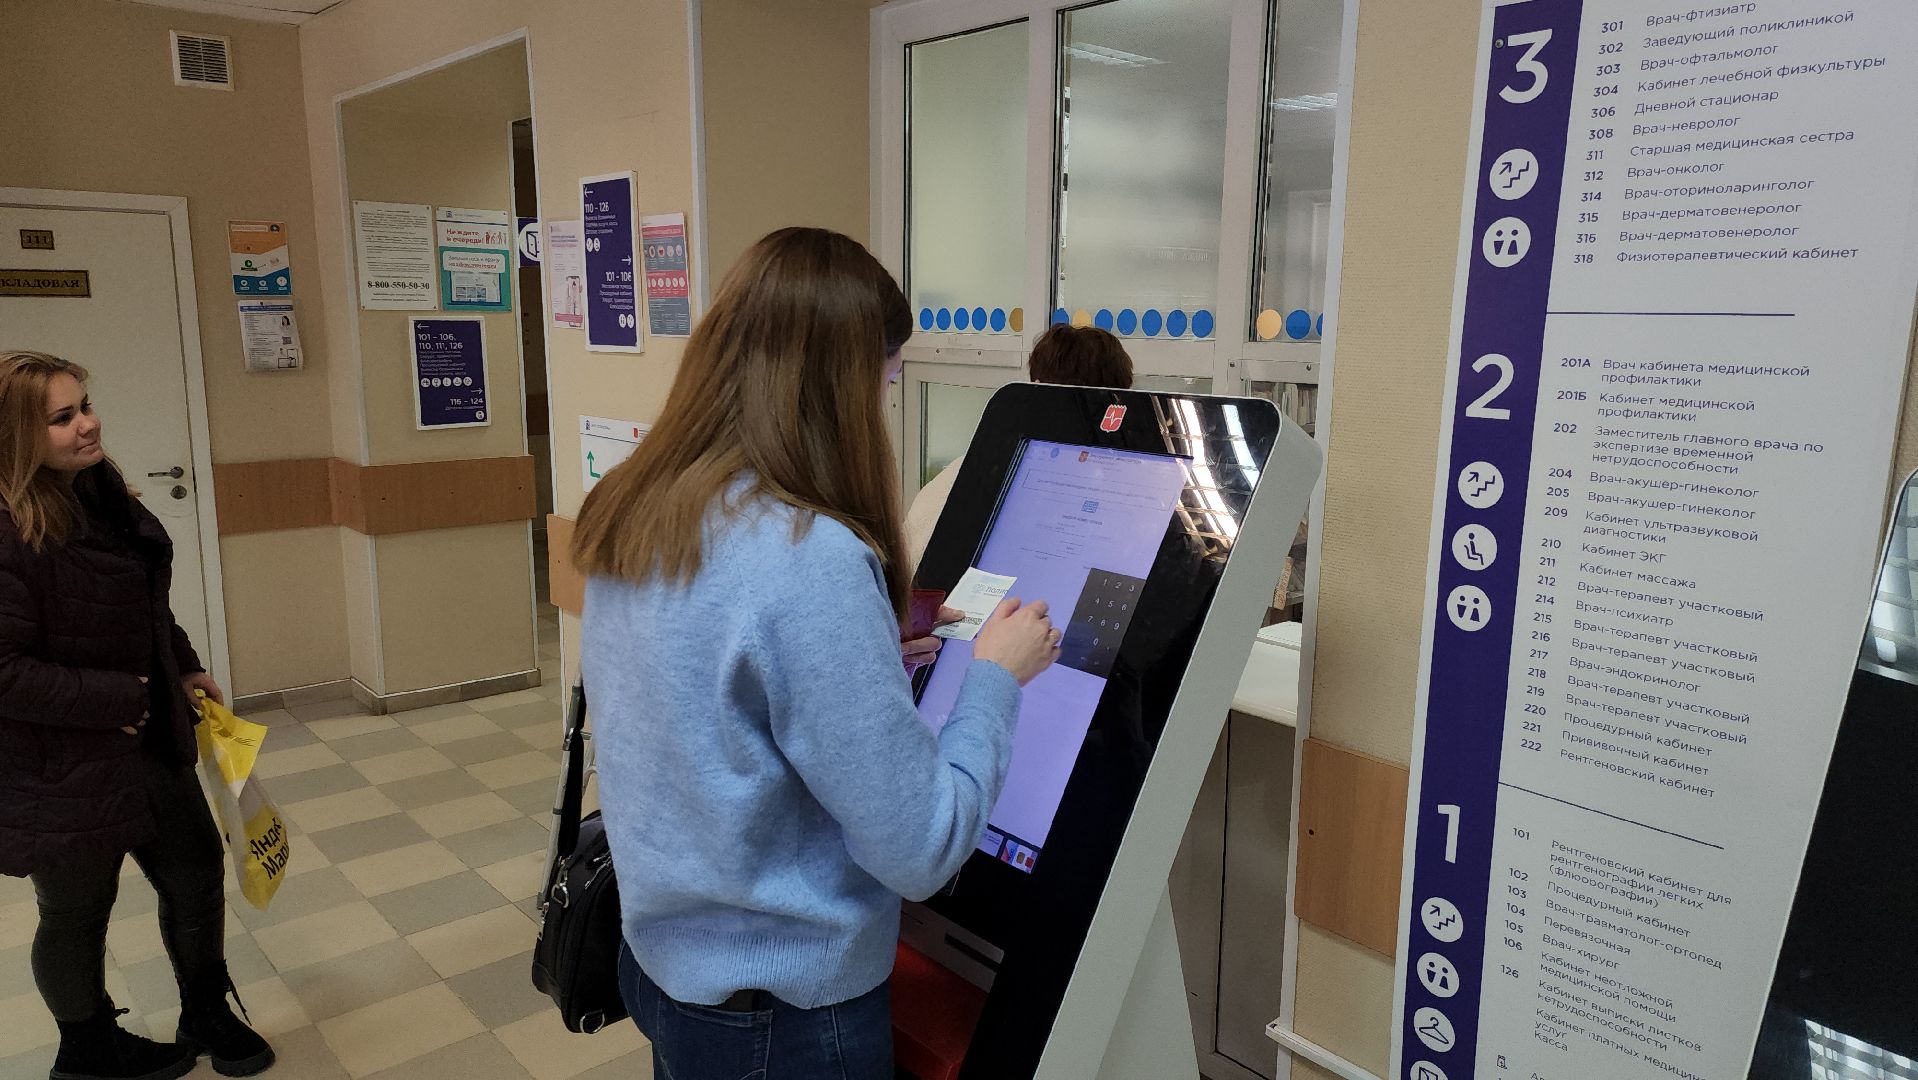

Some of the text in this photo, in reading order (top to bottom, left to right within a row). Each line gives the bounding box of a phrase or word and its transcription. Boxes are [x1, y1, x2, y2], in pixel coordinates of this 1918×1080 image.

[1647, 3, 1757, 27] Врач-фтизиатр
[1601, 21, 1623, 33] 301
[1643, 13, 1854, 48] Заведующий поликлиникой
[1598, 42, 1623, 54] 302
[1498, 28, 1553, 104] 3
[1641, 46, 1779, 71] Врач-офтальмолог
[1596, 64, 1621, 76] 303
[1638, 57, 1885, 92] Кабинет лечебной физкультуры
[1593, 85, 1618, 97] 304
[1634, 92, 1779, 116] Дневной стационар
[1591, 106, 1615, 118] 306
[1633, 117, 1741, 136] Врач-невролог
[1589, 129, 1613, 141] 308
[1630, 131, 1854, 157] Старшая медицинская сестра
[1585, 150, 1604, 160] 311
[1584, 171, 1603, 181] 312
[1628, 164, 1725, 179] Врач-онколог
[1581, 192, 1602, 202] 314
[1624, 181, 1815, 200] Врач-оториноларинголог
[1578, 212, 1598, 223] 315
[1621, 205, 1803, 222] Врач-дерматовенеролог
[26, 235, 48, 244] 111
[1576, 233, 1596, 243] 316
[1620, 227, 1800, 243] Врач-дерматовенеролог
[1573, 254, 1593, 263] 318
[1617, 247, 1859, 262] Физиотерапевтический кабинет
[605, 271, 615, 282] 101
[418, 333, 431, 341] 101
[1561, 358, 1592, 368] 201А
[1603, 359, 1809, 376] Врач кабинета медицинской
[1465, 353, 1515, 420] 2
[1602, 374, 1701, 387] профилактики
[1557, 390, 1586, 400] 201Б
[1600, 393, 1754, 410] Кабинет медицинской
[1598, 408, 1696, 422] профилактики
[1554, 423, 1577, 433] 202
[1595, 425, 1823, 452] Заместитель главного врача по
[1593, 442, 1753, 462] экспертизе временной
[1593, 454, 1738, 474] нетрудоспособности
[1548, 468, 1572, 478] 204
[1547, 487, 1569, 497] 205
[1589, 472, 1759, 498] Врач-акушер-гинеколог
[1544, 507, 1567, 517] 209
[1588, 492, 1756, 519] Врач-акушер-гинеколог
[1586, 509, 1758, 541] Кабинет ультразвуковой
[1583, 526, 1666, 543] диагностики
[1541, 538, 1561, 549] 210
[1582, 543, 1667, 564] Кабинет ЭКГ
[1538, 557, 1555, 567] 211
[1537, 574, 1555, 586] 212
[1580, 563, 1696, 588] Кабинет массажа
[1103, 578, 1108, 586] 1
[1115, 581, 1122, 589] 2
[1095, 597, 1100, 605] 4
[1108, 600, 1115, 608] 5
[1535, 594, 1554, 605] 214
[1578, 582, 1763, 622] Врач-терапевт участковый
[1087, 615, 1120, 630] 7 8 9
[1533, 612, 1552, 623] 215
[1093, 638, 1099, 646] 0
[1532, 631, 1550, 642] 216
[1574, 619, 1757, 662] Врач-терапевт участковый
[1529, 649, 1549, 659] 217
[1571, 638, 1754, 683] Врач-терапевт участковый
[1528, 668, 1546, 679] 218
[1570, 657, 1701, 692] Врач-эндокринолог
[1526, 685, 1544, 696] 219
[1568, 675, 1749, 724] Врач-терапевт участковый
[1524, 704, 1546, 715] 220
[1566, 693, 1747, 744] Врач-терапевт участковый
[1523, 721, 1542, 733] 221
[1565, 712, 1712, 756] Процедурный кабинет
[1520, 739, 1541, 752] 222
[1563, 731, 1709, 775] Прививочный кабинет
[1561, 749, 1715, 797] Рентгеновский кабинет
[1437, 804, 1461, 864] 1
[1513, 828, 1529, 840] 101
[1509, 868, 1528, 881] 102
[1552, 840, 1731, 904] Рентгеновский кабинет для
[1550, 864, 1659, 908] (флюорографии)
[1551, 854, 1704, 909] рентгенографии легких
[1508, 885, 1528, 898] 103
[1507, 903, 1525, 916] 104
[1548, 881, 1691, 938] Процедурный кабинет
[1505, 920, 1523, 933] 105
[1545, 899, 1721, 970] Врач-травматолог-ортопед
[1545, 916, 1630, 955] Перевязочная
[1504, 937, 1522, 951] 106
[1543, 934, 1620, 969] Врач-хирург
[1501, 965, 1520, 978] 126
[1542, 951, 1672, 1009] Кабинет неотложной
[1540, 964, 1676, 1022] медицинской помощи
[1537, 1008, 1585, 1035] Кабинет
[1538, 992, 1667, 1052] нетрудоспособности
[1539, 980, 1701, 1051] Кабинет выписки листков
[1535, 1020, 1567, 1038] услуг
[1535, 1030, 1567, 1052] Касса
